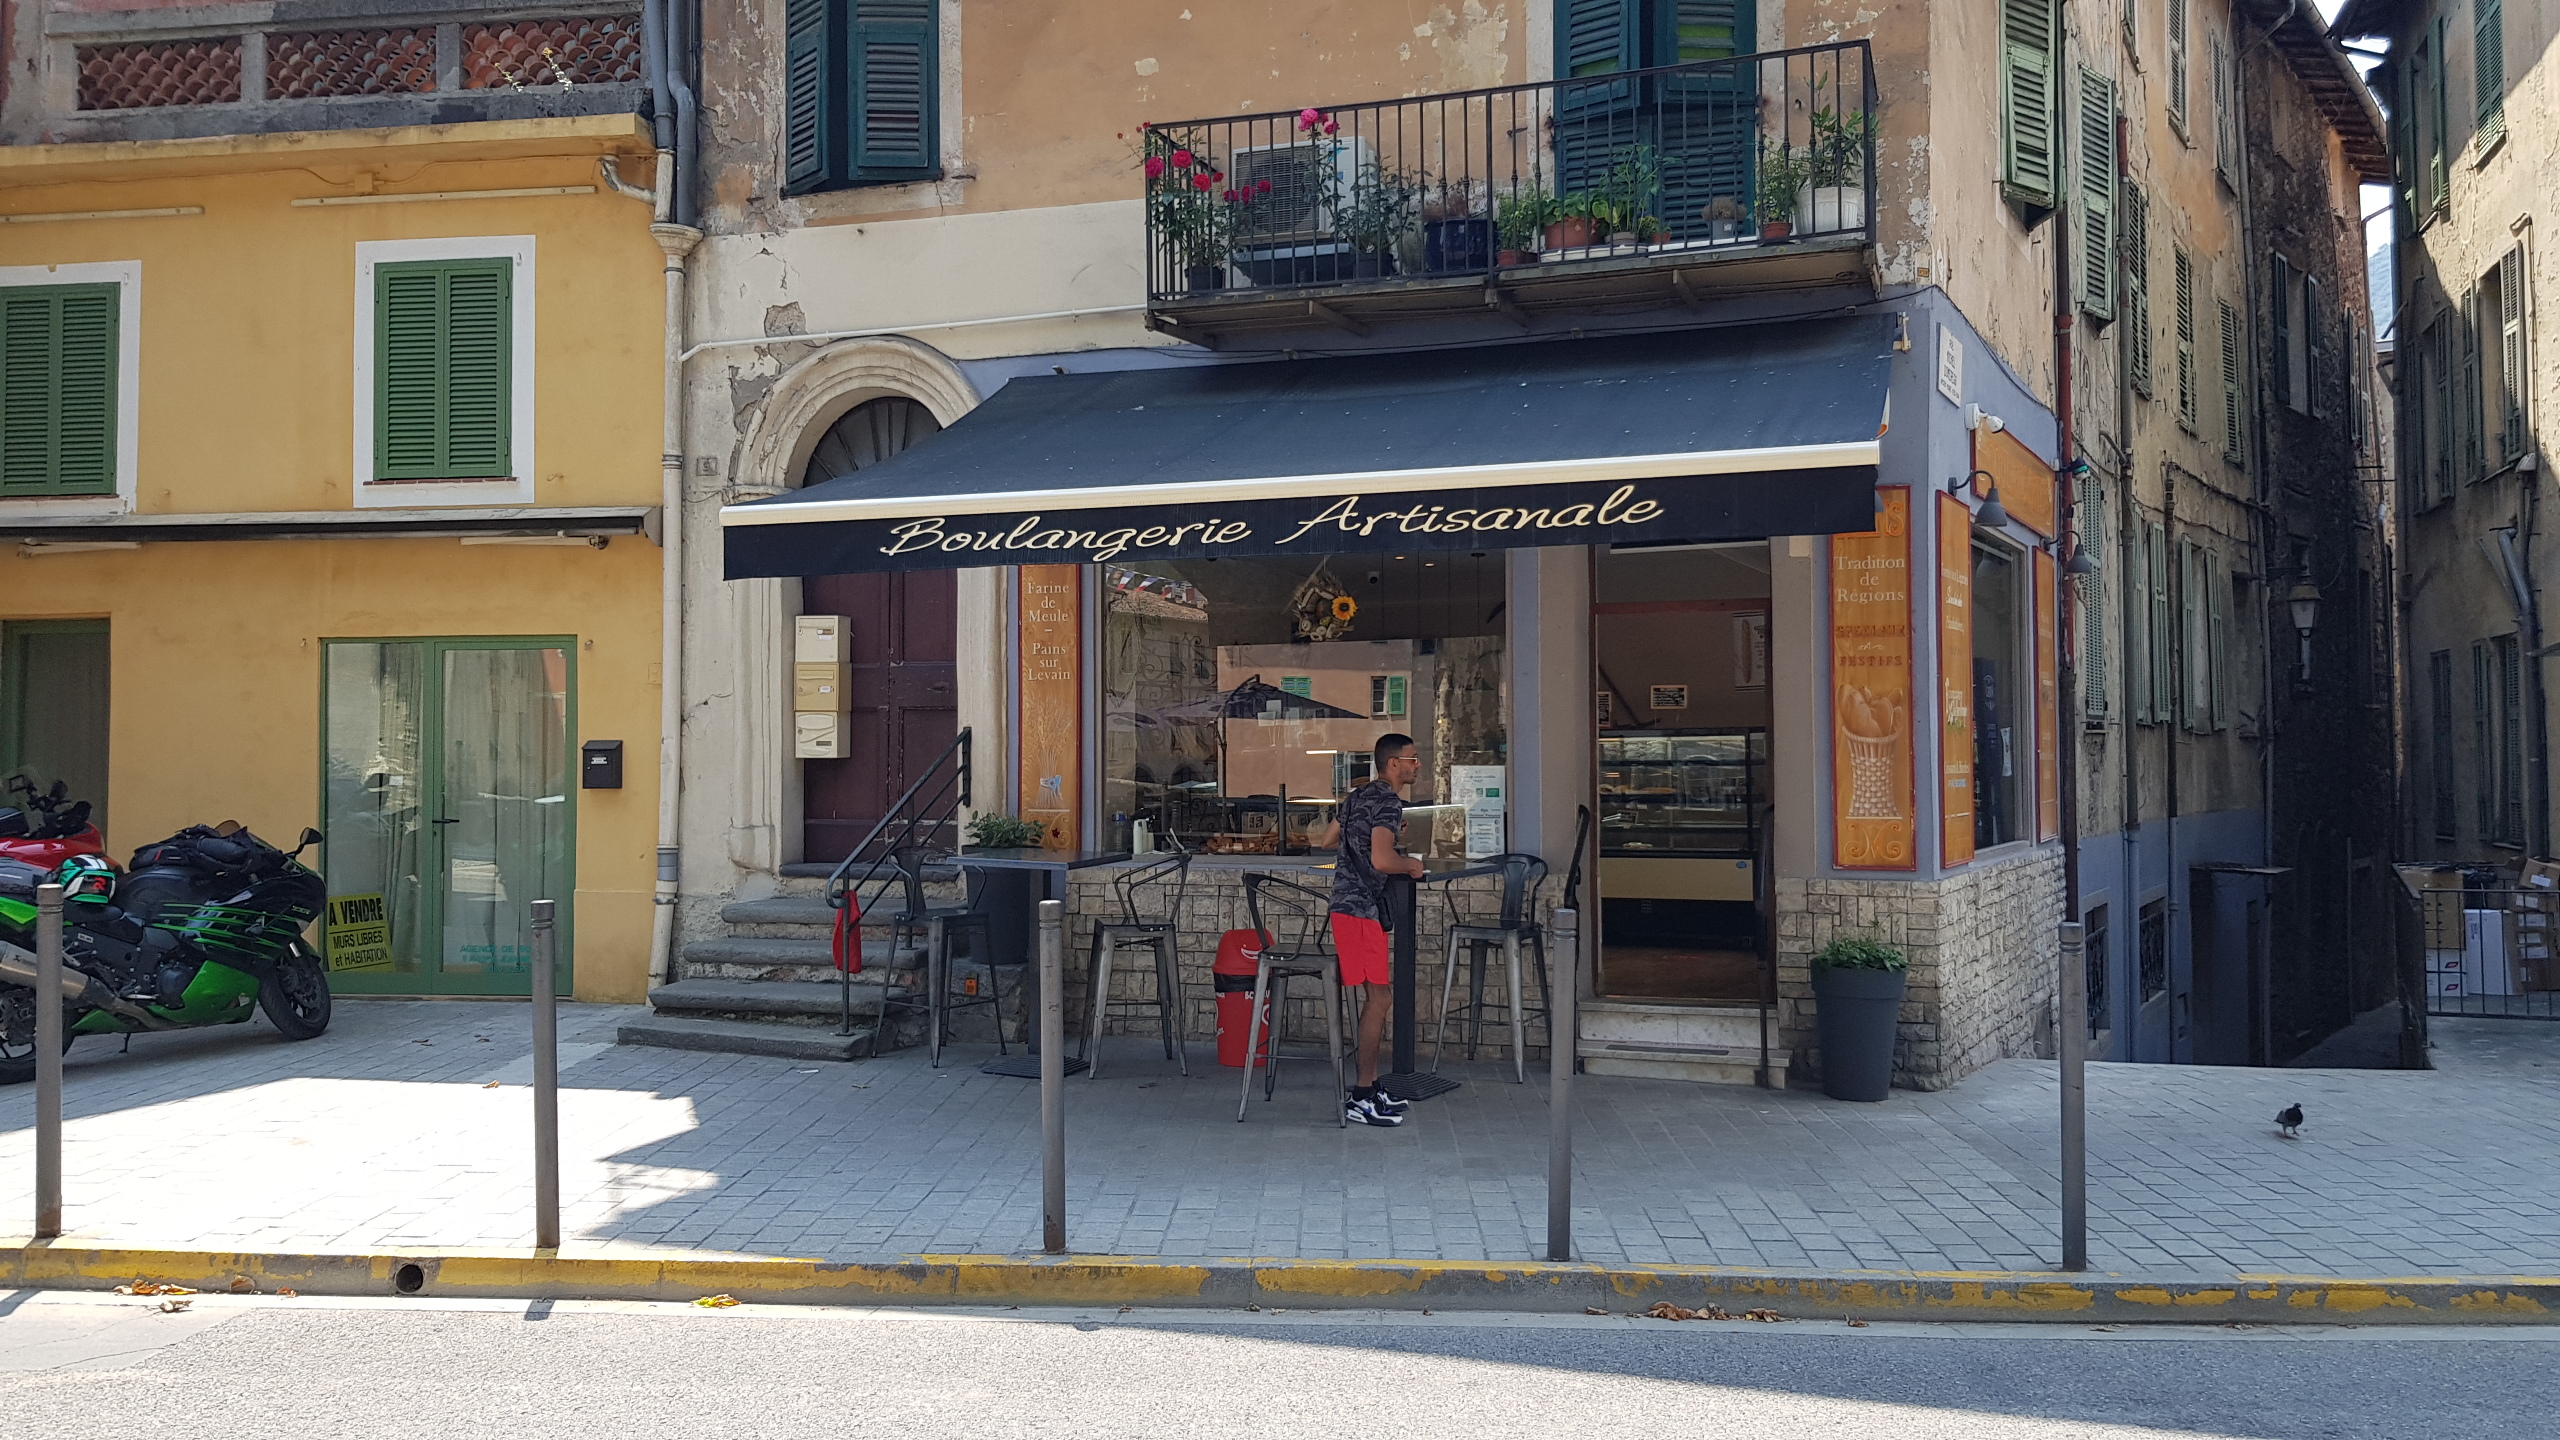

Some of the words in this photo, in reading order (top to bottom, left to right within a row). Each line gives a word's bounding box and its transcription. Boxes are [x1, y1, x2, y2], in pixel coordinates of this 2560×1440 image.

[880, 516, 1253, 562] Boulangerie
[1275, 485, 1664, 544] Artisanale
[1834, 555, 1905, 571] Tradition
[1860, 572, 1879, 586] de
[1028, 581, 1070, 594] Farine
[1041, 596, 1056, 609] de
[1836, 588, 1905, 605] Régions
[1029, 609, 1069, 622] Meule
[1032, 642, 1067, 655] Pains
[1040, 659, 1059, 668] sur
[1028, 667, 1071, 681] Levain
[329, 902, 338, 927] A
[339, 897, 384, 925] VENDRE
[333, 934, 355, 949] MURS
[356, 930, 384, 946] LIBRES
[335, 953, 343, 967] et
[344, 947, 388, 966] HABITATION
